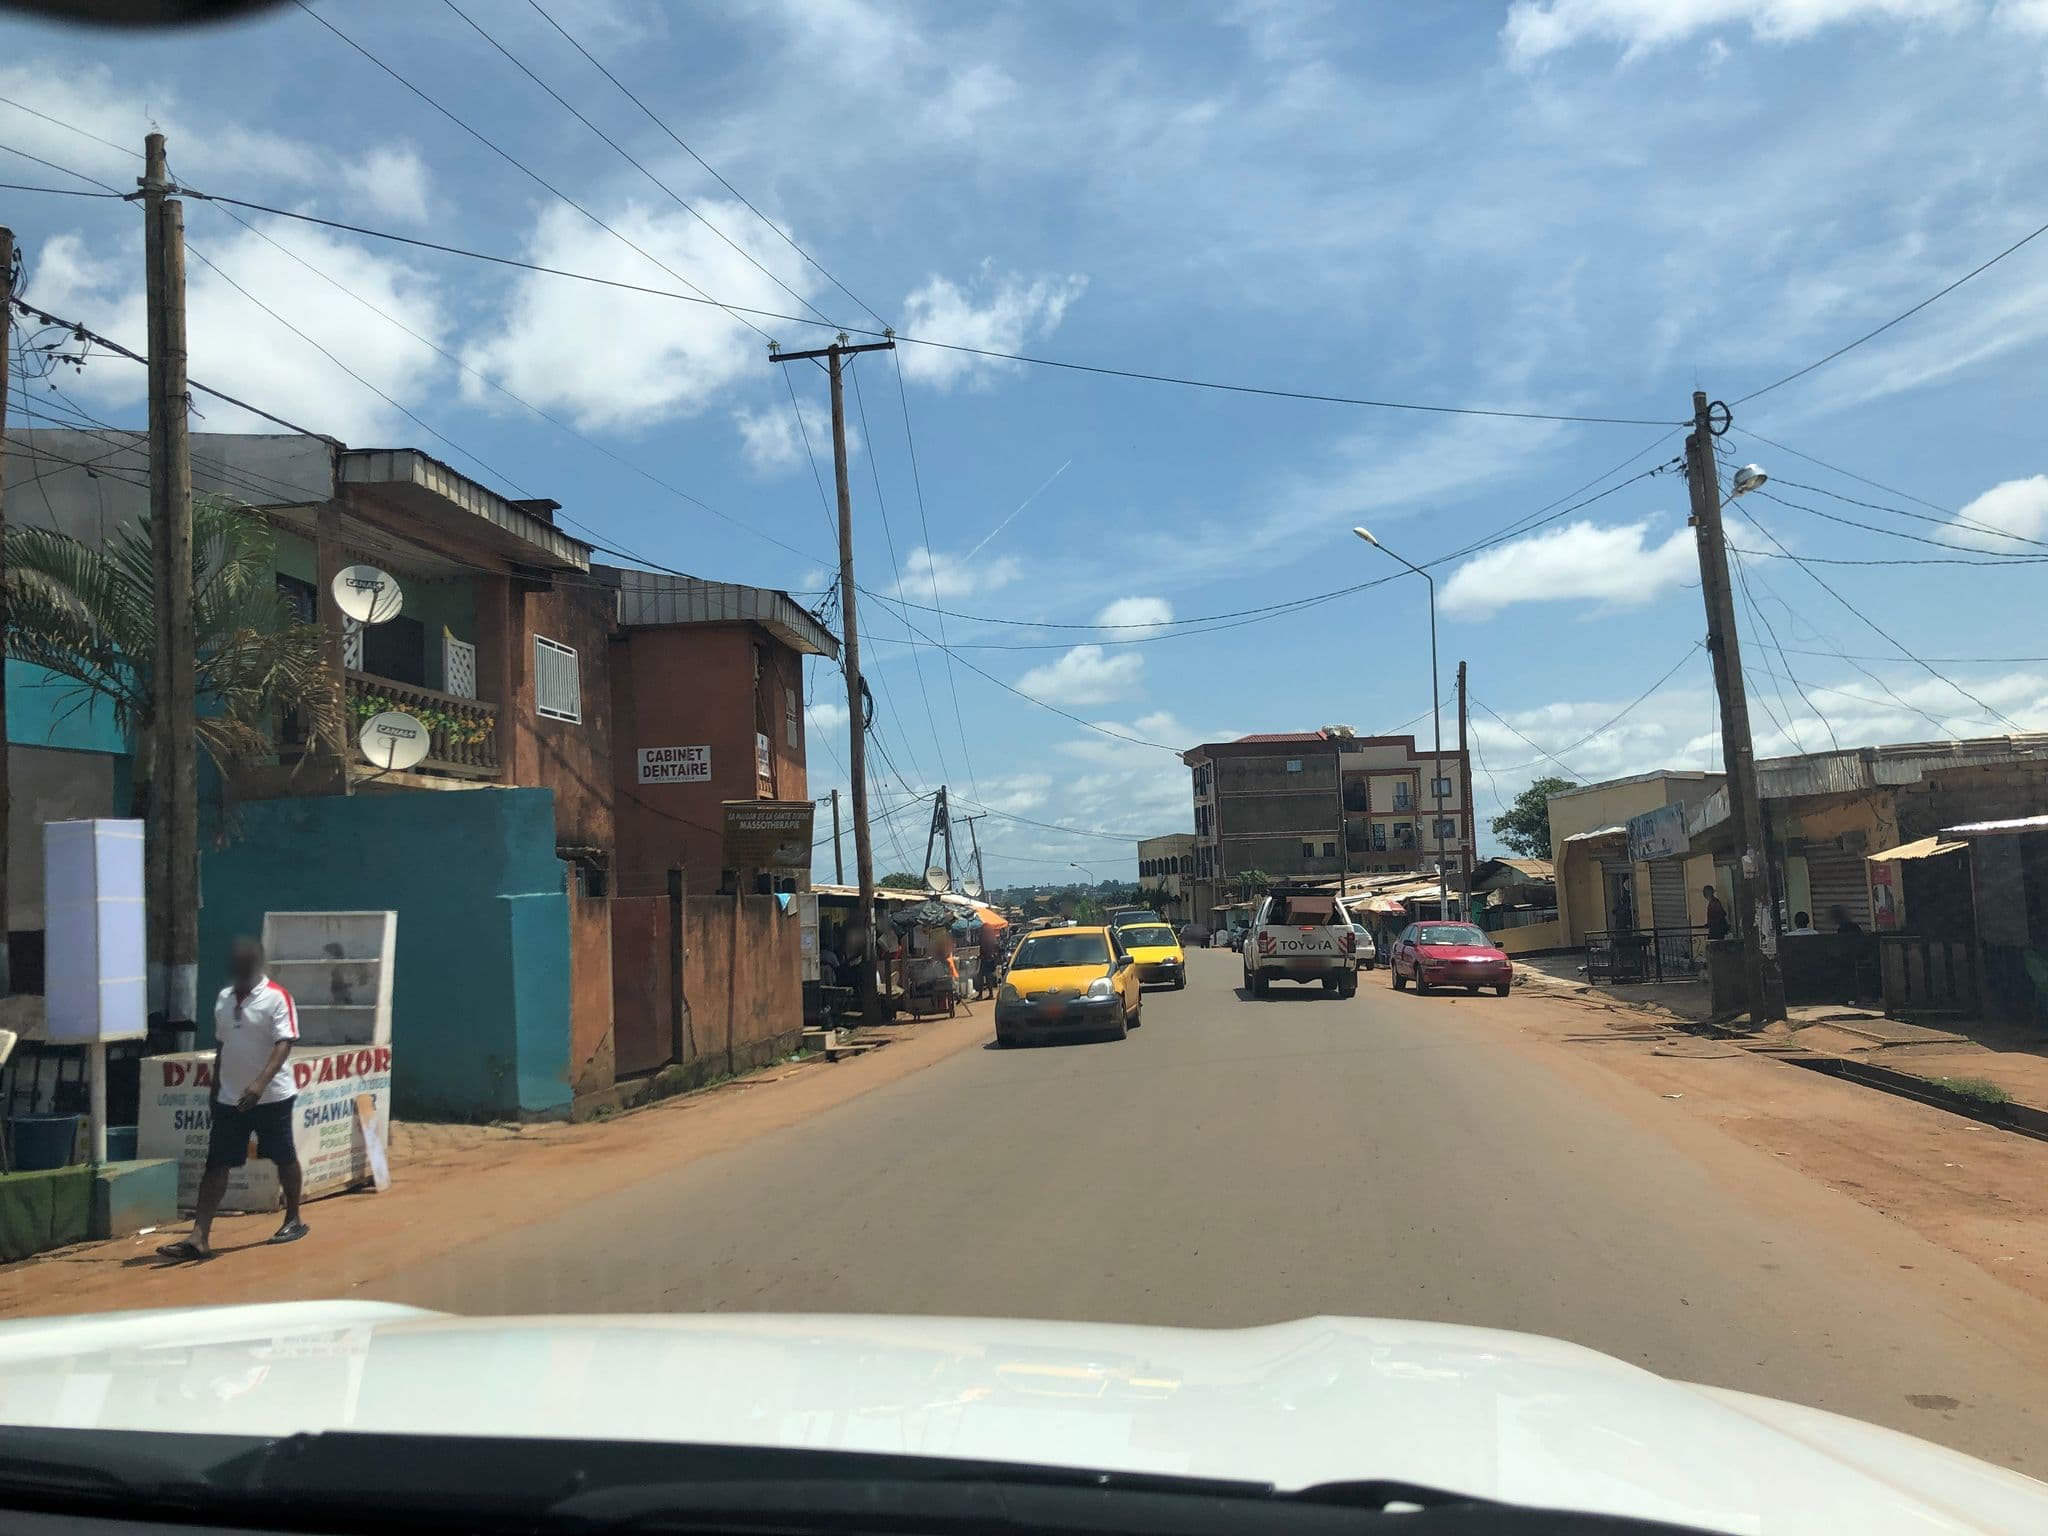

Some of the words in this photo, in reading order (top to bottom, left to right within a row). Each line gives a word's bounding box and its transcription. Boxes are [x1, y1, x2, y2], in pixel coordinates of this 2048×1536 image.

[378, 726, 415, 739] CANAL+
[646, 748, 703, 764] CABINET
[643, 763, 708, 778] DENTAIRE
[292, 1047, 391, 1090] D'AKOR
